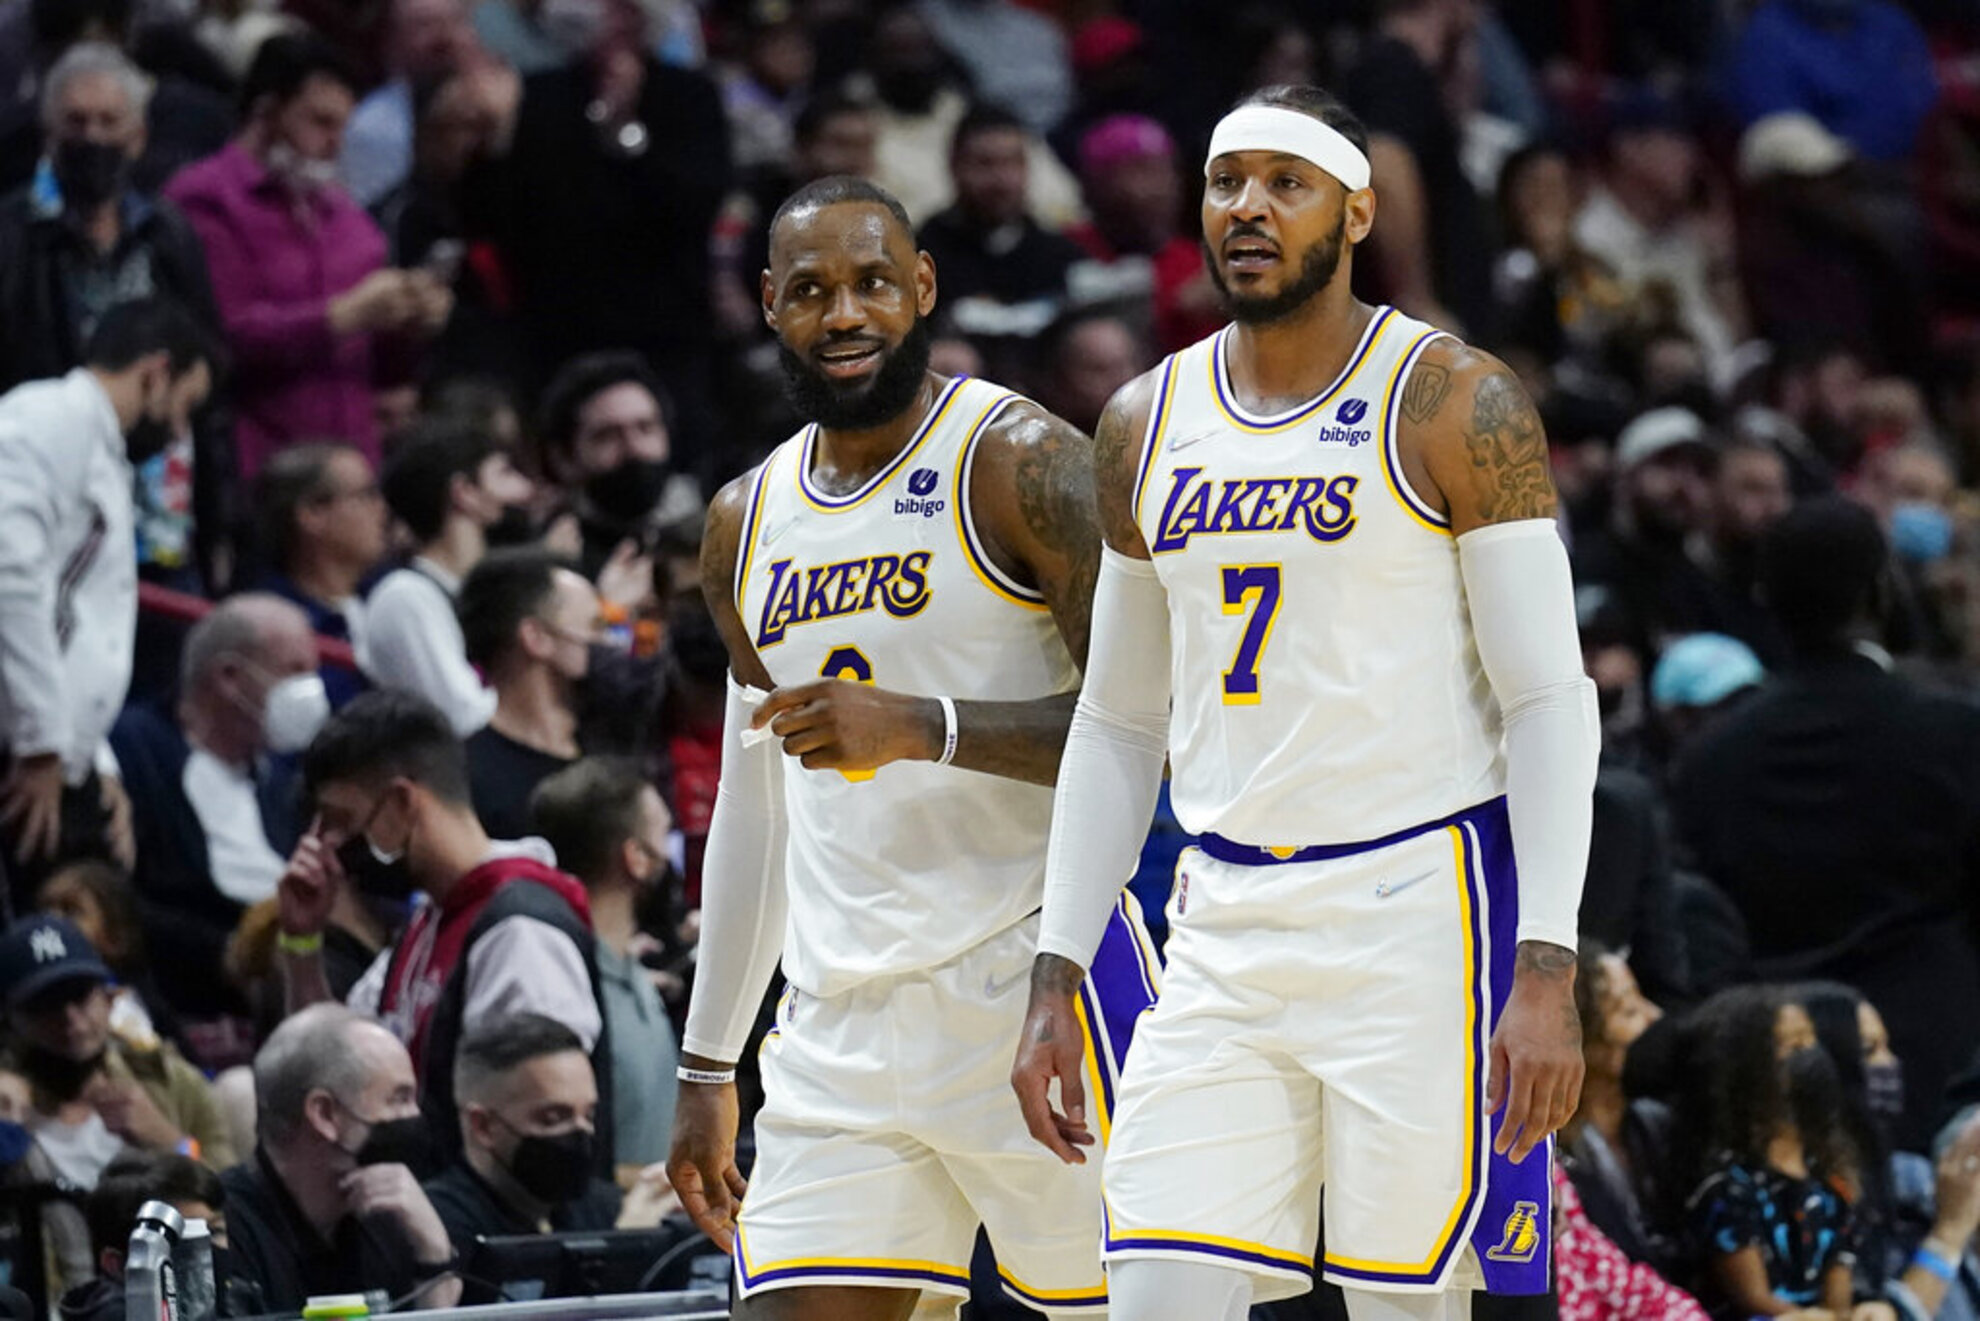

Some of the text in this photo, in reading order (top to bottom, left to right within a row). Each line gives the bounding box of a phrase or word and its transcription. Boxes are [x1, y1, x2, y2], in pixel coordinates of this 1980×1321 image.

[1319, 427, 1371, 446] bibigo
[894, 498, 945, 518] bibigo
[1150, 465, 1361, 557] LAKERS
[756, 551, 935, 652] LAKERS
[1219, 562, 1284, 705] 7
